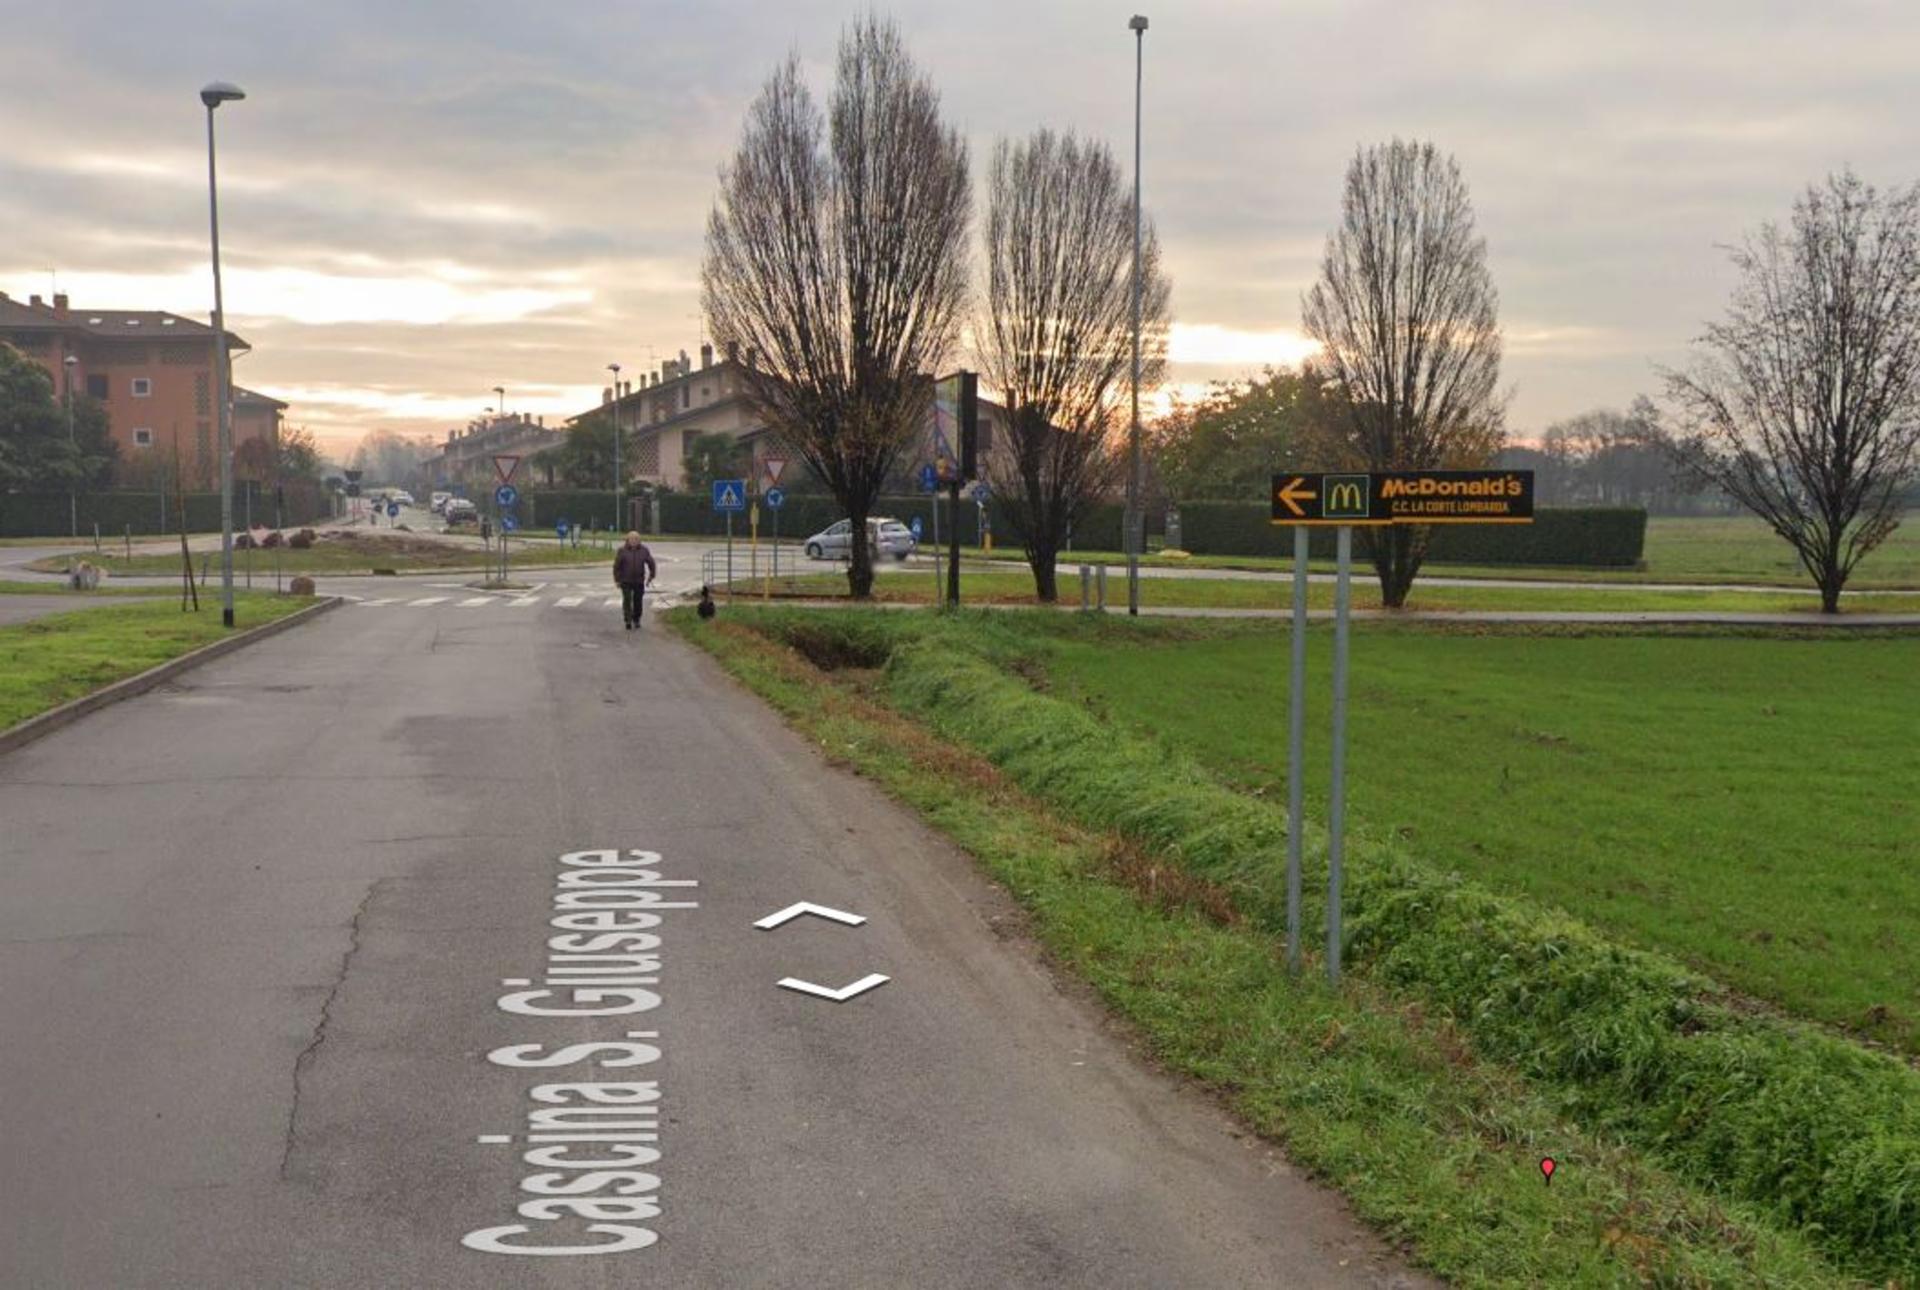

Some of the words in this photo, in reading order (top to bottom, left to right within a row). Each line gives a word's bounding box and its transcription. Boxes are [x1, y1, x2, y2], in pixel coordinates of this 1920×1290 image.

[1381, 474, 1522, 498] McDonald's
[1391, 501, 1411, 513] C.C.
[1411, 501, 1425, 513] LA
